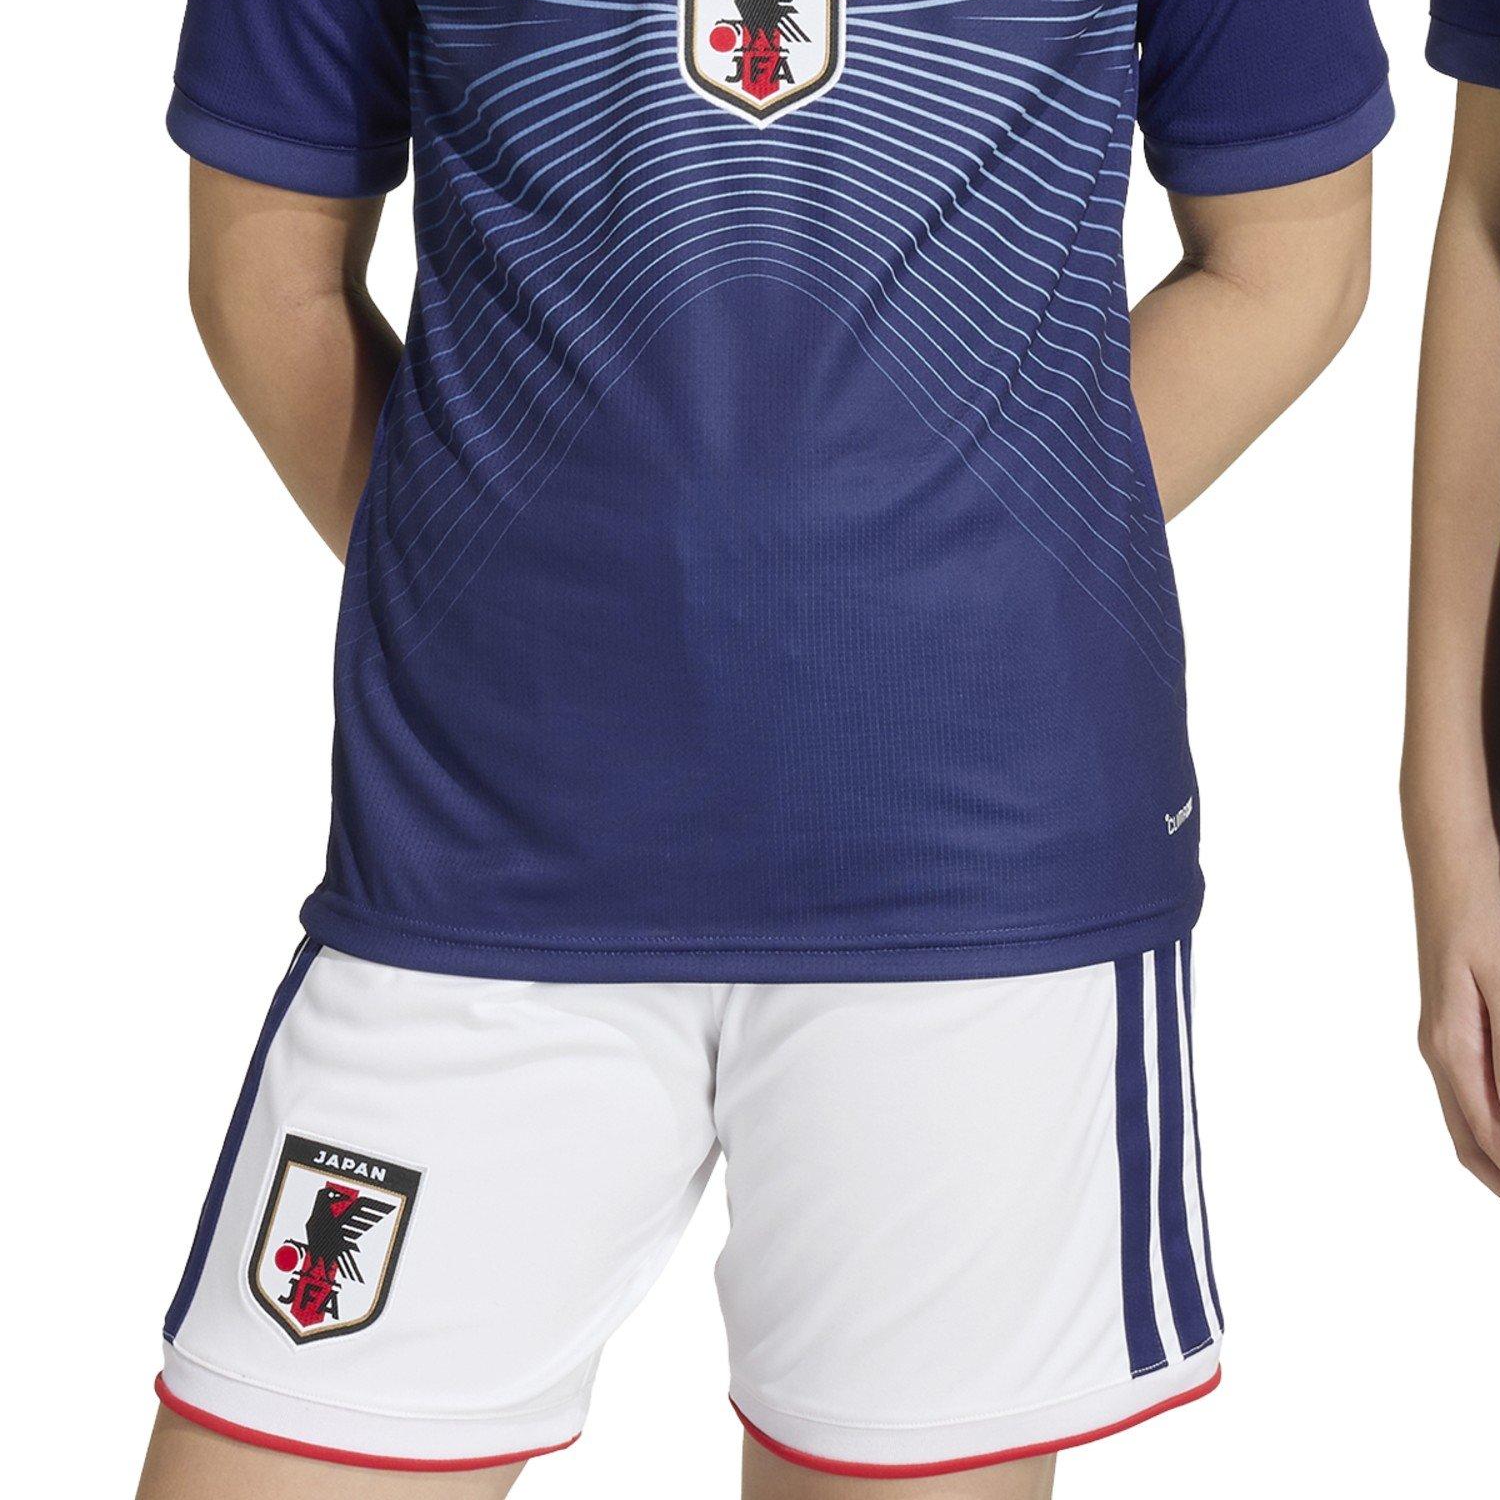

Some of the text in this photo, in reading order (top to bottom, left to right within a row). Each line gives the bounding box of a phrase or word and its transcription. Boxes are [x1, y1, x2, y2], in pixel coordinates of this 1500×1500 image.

[724, 56, 795, 84] JFA
[313, 1150, 387, 1182] JAPAN
[277, 1277, 339, 1320] JFA
